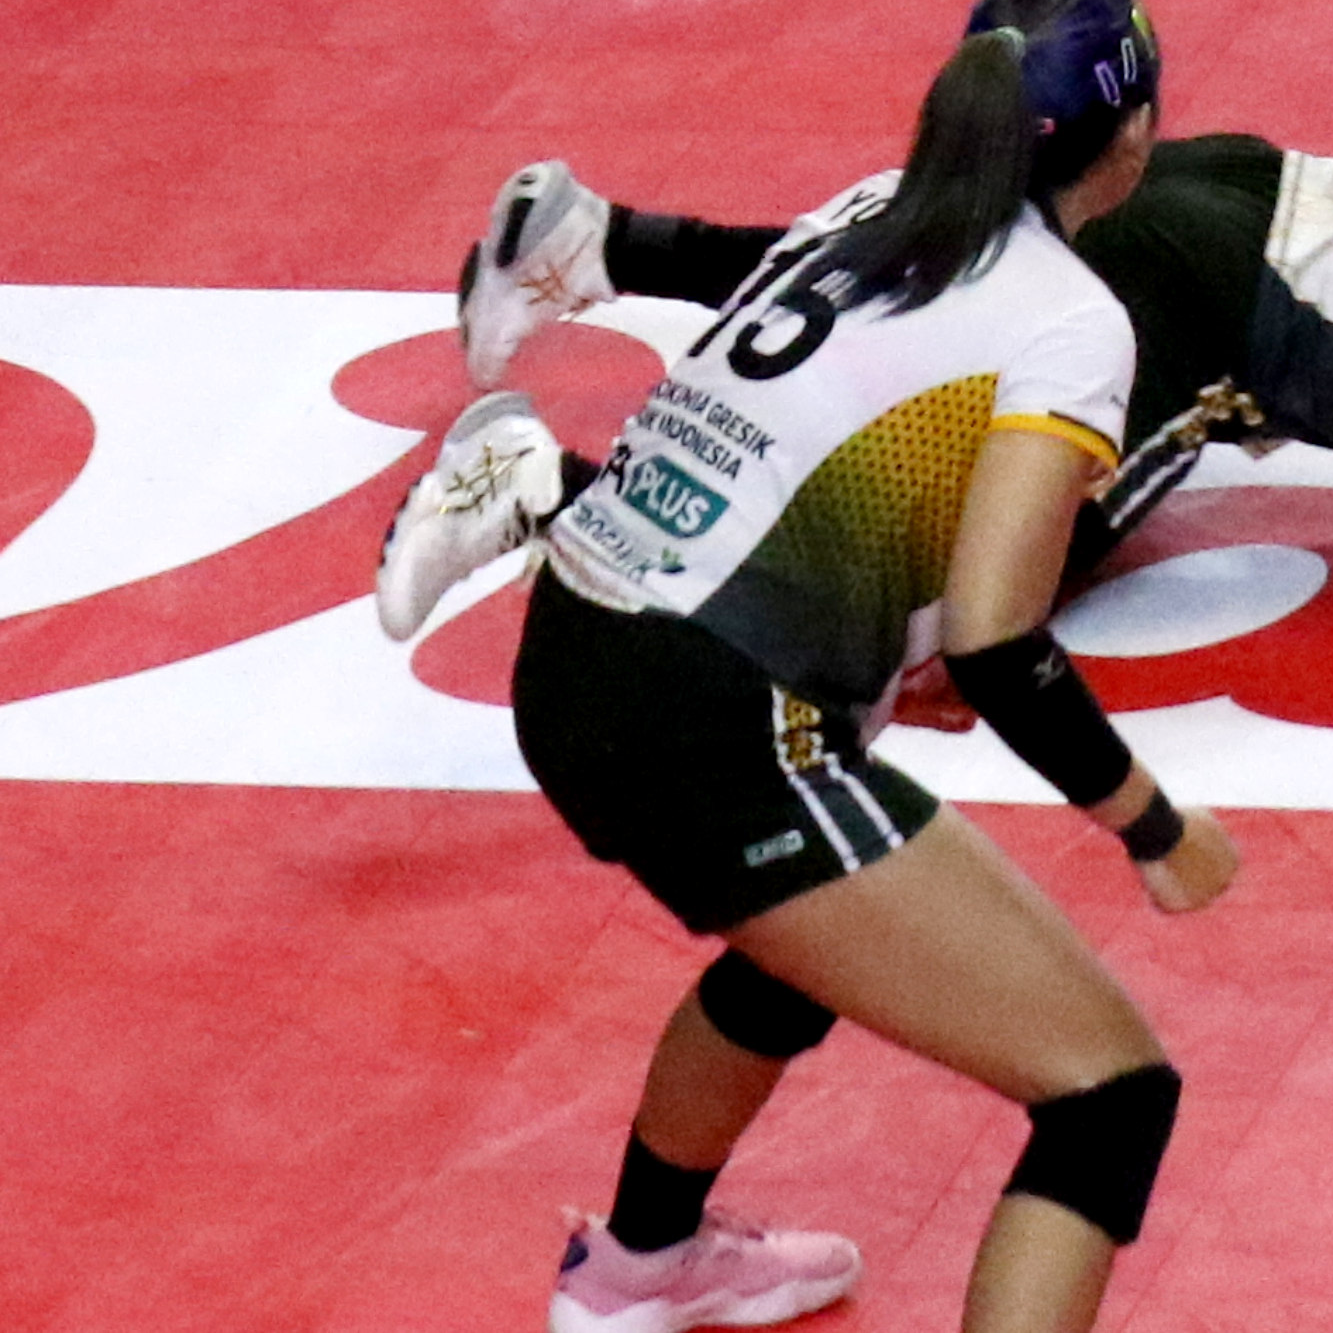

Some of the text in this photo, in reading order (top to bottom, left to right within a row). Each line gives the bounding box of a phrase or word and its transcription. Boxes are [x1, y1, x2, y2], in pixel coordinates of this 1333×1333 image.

[657, 413, 743, 481] INDONESIA
[706, 401, 776, 461] GRESIK
[631, 461, 710, 533] PLUS
